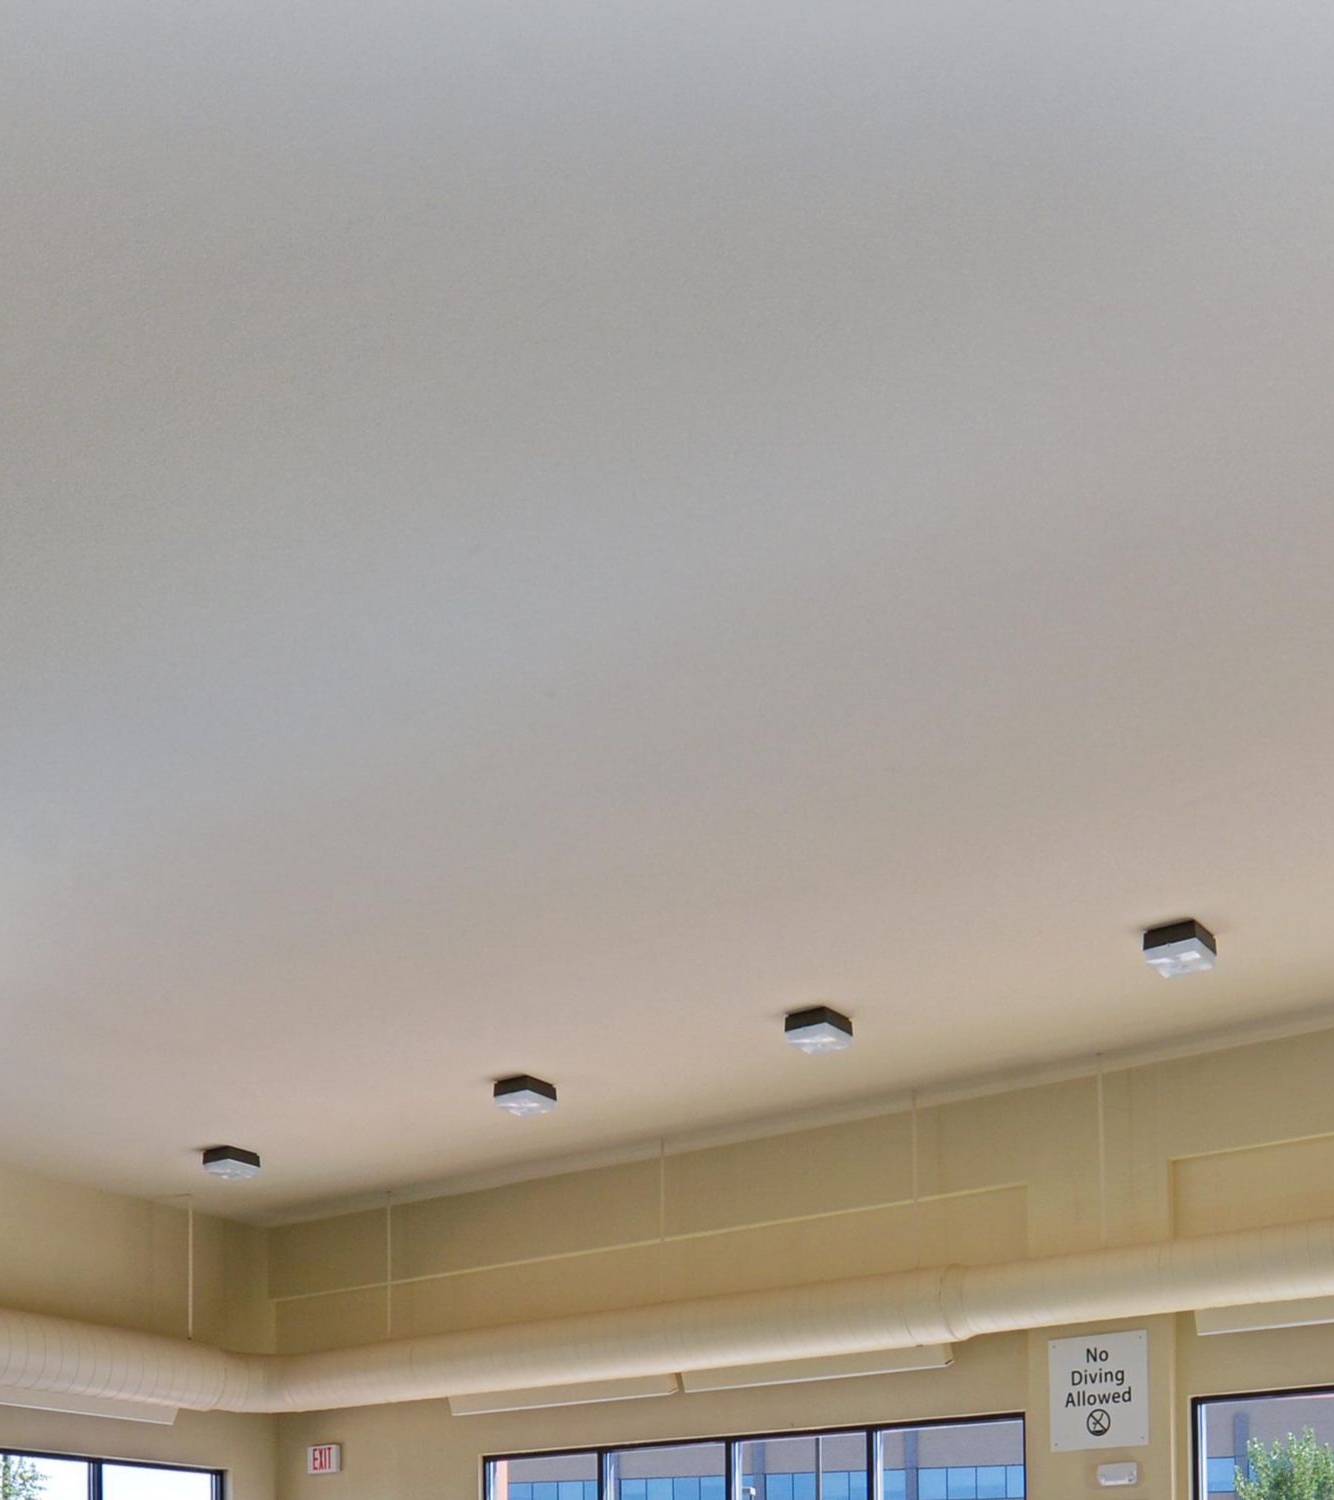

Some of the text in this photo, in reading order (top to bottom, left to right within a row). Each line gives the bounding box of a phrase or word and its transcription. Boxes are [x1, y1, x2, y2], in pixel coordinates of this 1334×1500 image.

[1086, 1347, 1109, 1363] No
[1071, 1368, 1125, 1386] Diving
[1065, 1386, 1132, 1408] Allowed
[313, 1447, 332, 1471] EXIT
